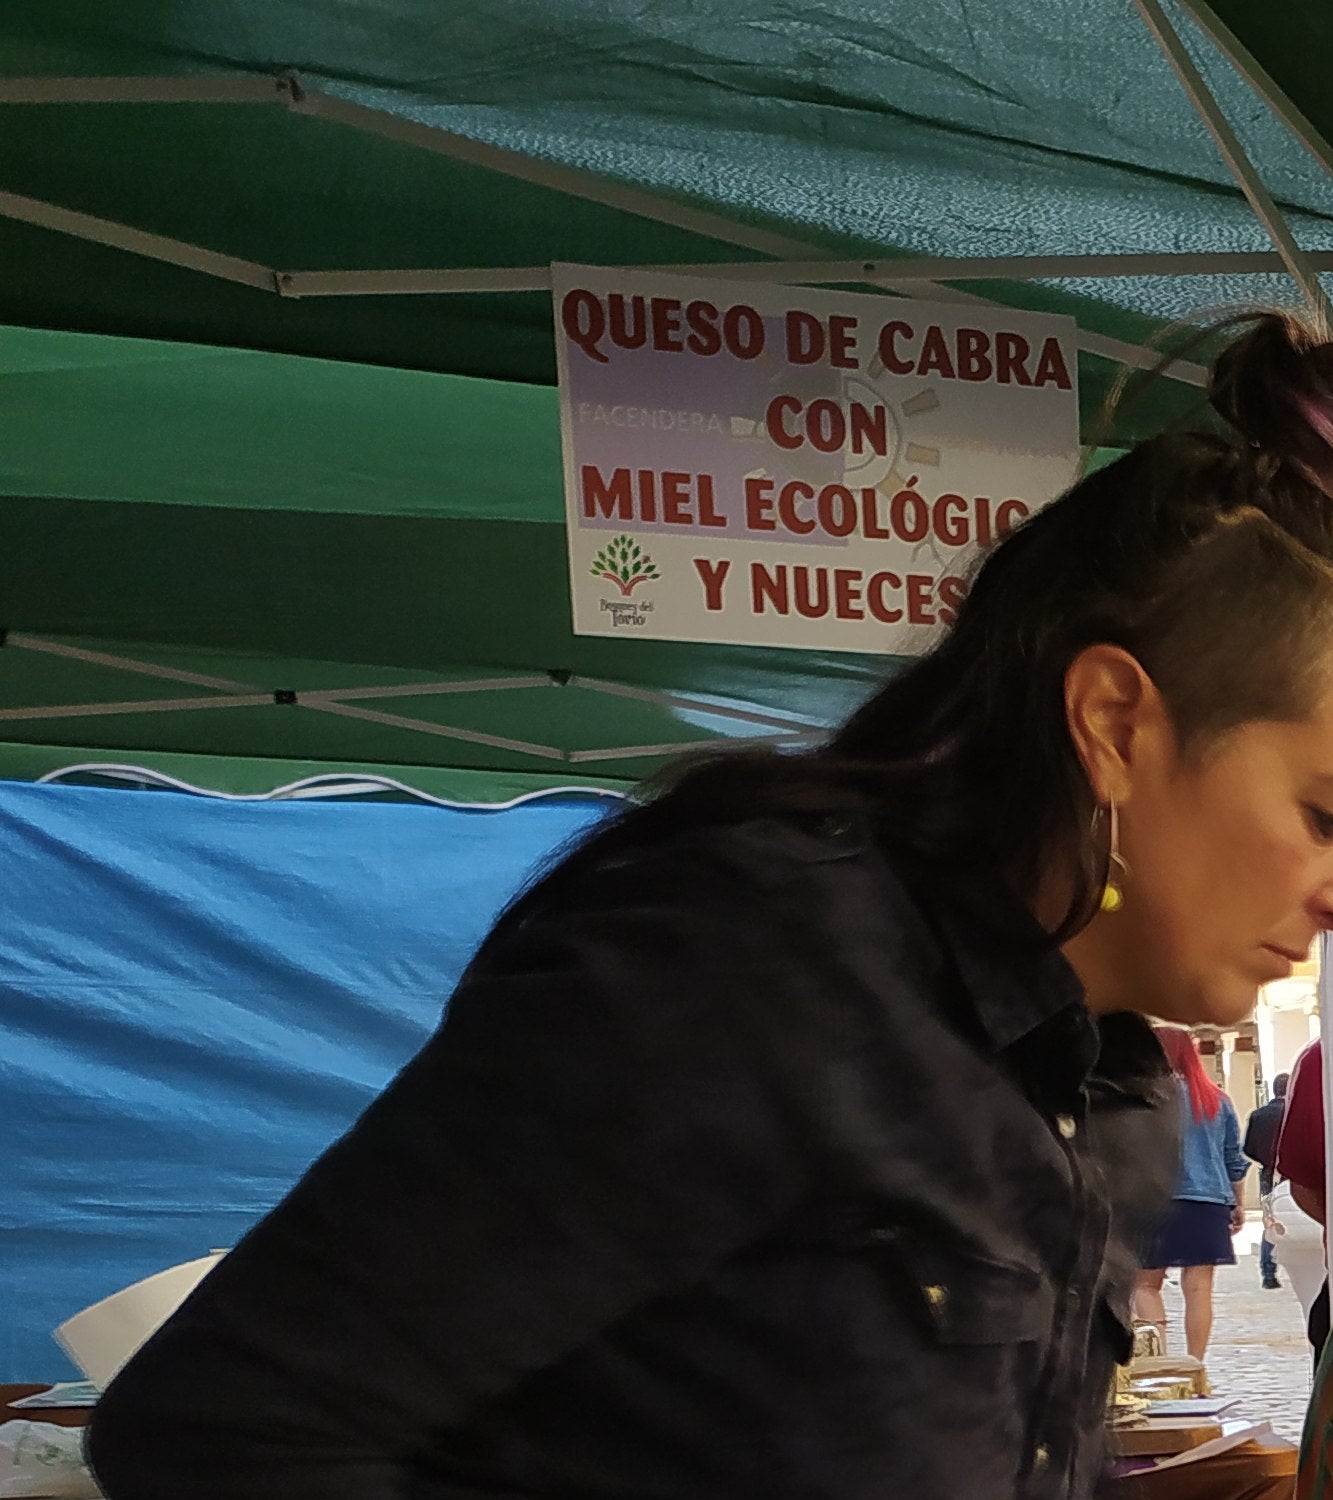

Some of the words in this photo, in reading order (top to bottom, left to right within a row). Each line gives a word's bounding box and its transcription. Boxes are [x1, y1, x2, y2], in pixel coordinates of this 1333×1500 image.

[562, 288, 766, 363] QUESO
[786, 310, 859, 369] DE
[878, 321, 1073, 390] CABRA
[766, 394, 888, 457] CON
[581, 464, 728, 528] MIEL
[745, 475, 1030, 549] ECOLÓGIC
[693, 558, 731, 611] Y
[751, 562, 969, 627] NUECES
